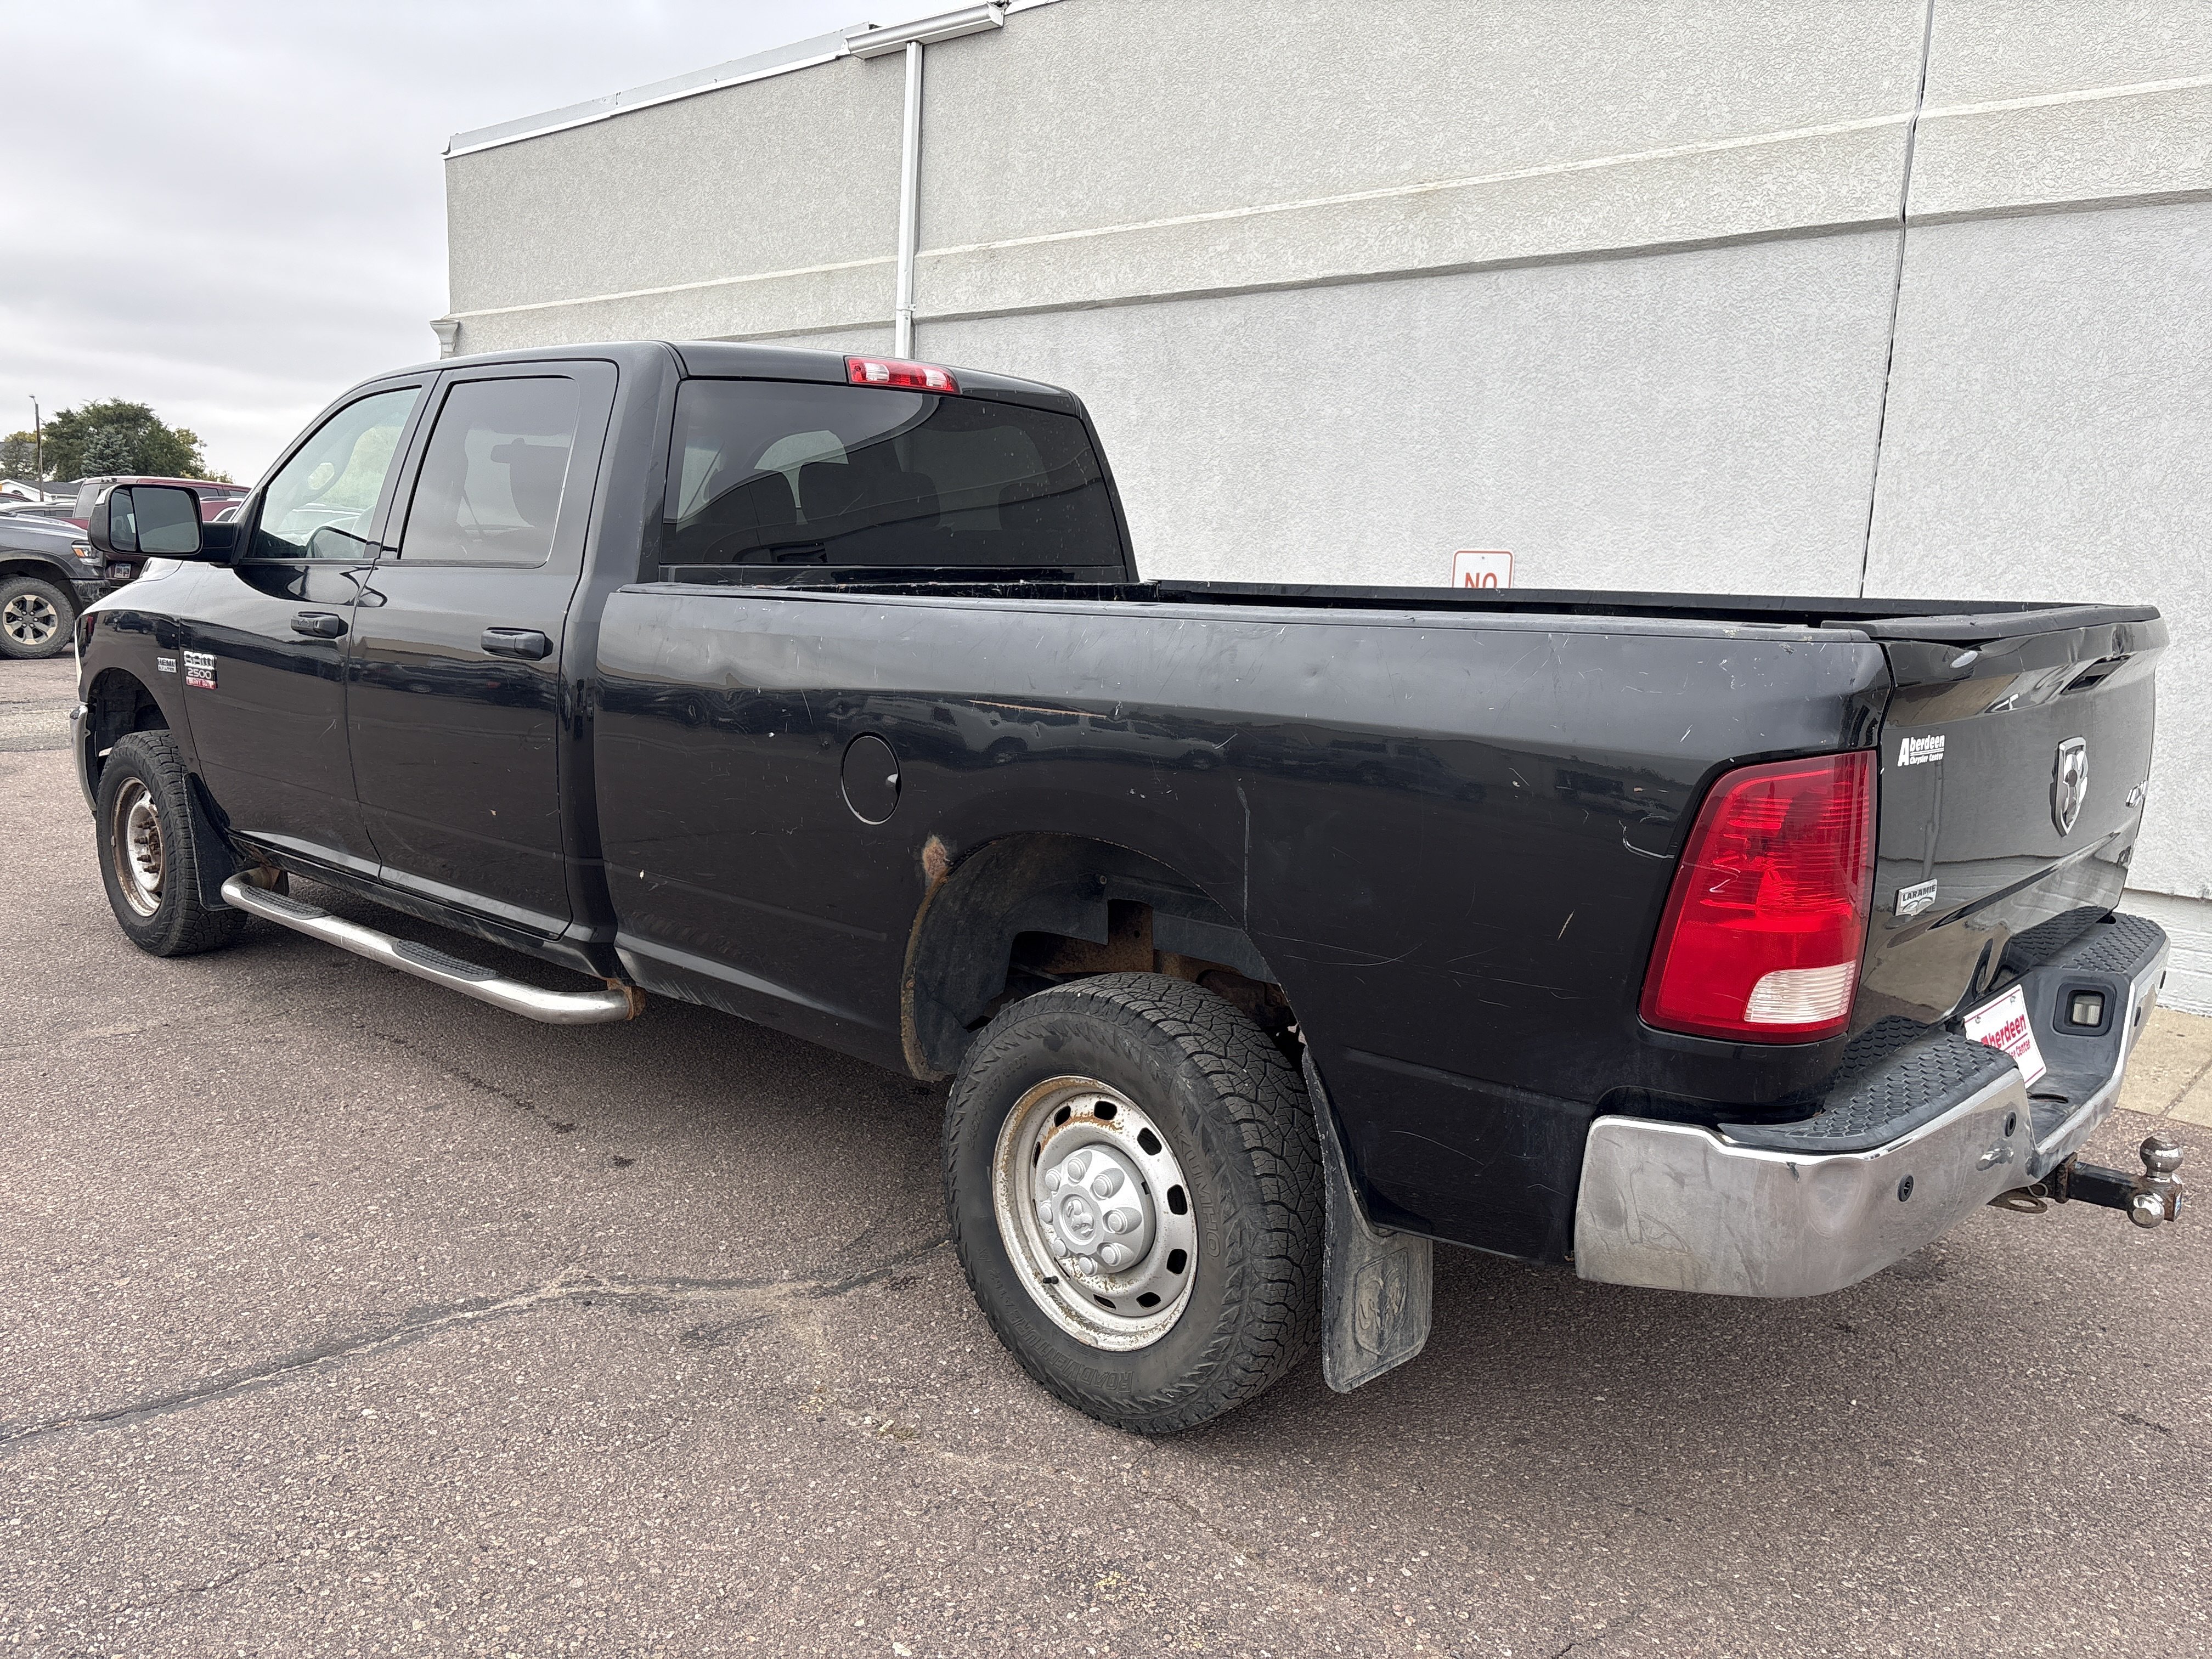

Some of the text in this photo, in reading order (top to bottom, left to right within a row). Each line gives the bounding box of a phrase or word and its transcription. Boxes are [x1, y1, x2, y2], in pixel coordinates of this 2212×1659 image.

[1465, 573, 1497, 588] NO
[157, 659, 176, 667] HEMI
[187, 668, 212, 680] 2500
[1897, 734, 1945, 767] Aberdeen
[1910, 753, 1944, 765] Chrysler Center
[1902, 884, 1936, 902] LARAMIE
[2016, 1039, 2031, 1057] Center
[1171, 1125, 1221, 1259] KUMHO
[1004, 1307, 1135, 1395] ROADVENTURE
